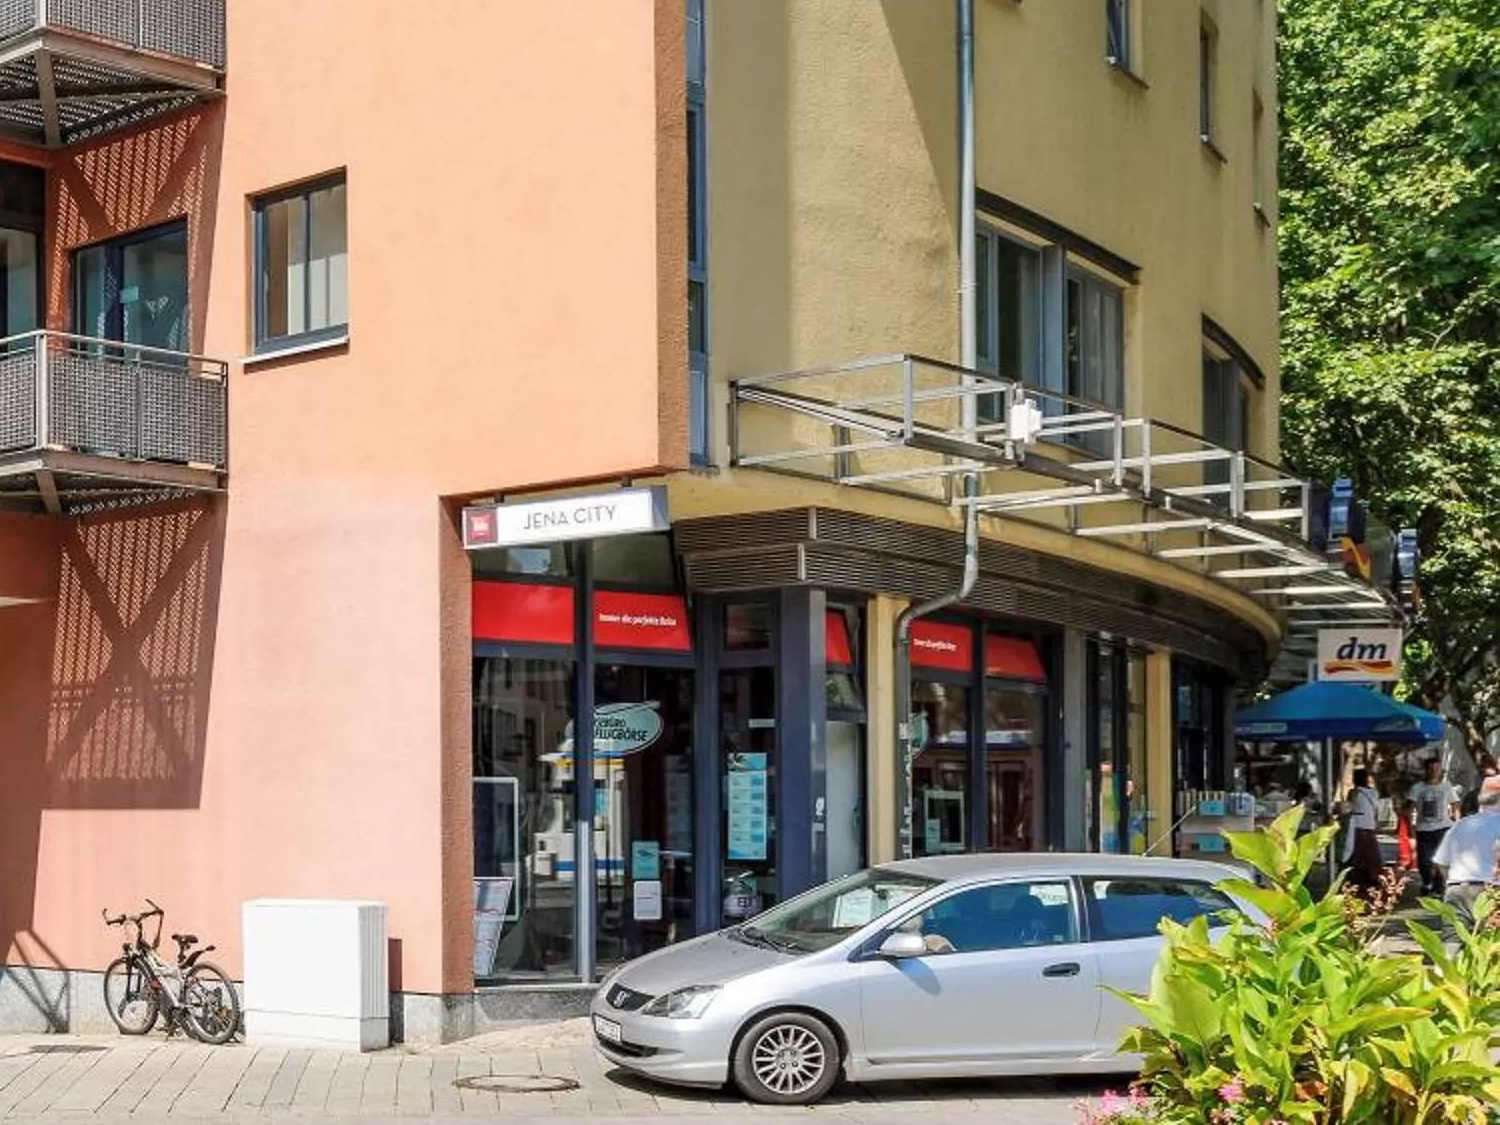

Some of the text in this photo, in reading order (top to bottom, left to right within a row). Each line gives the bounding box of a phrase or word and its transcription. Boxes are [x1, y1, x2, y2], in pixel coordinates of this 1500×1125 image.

[523, 504, 617, 530] JENA CITY
[1337, 637, 1388, 660] dm
